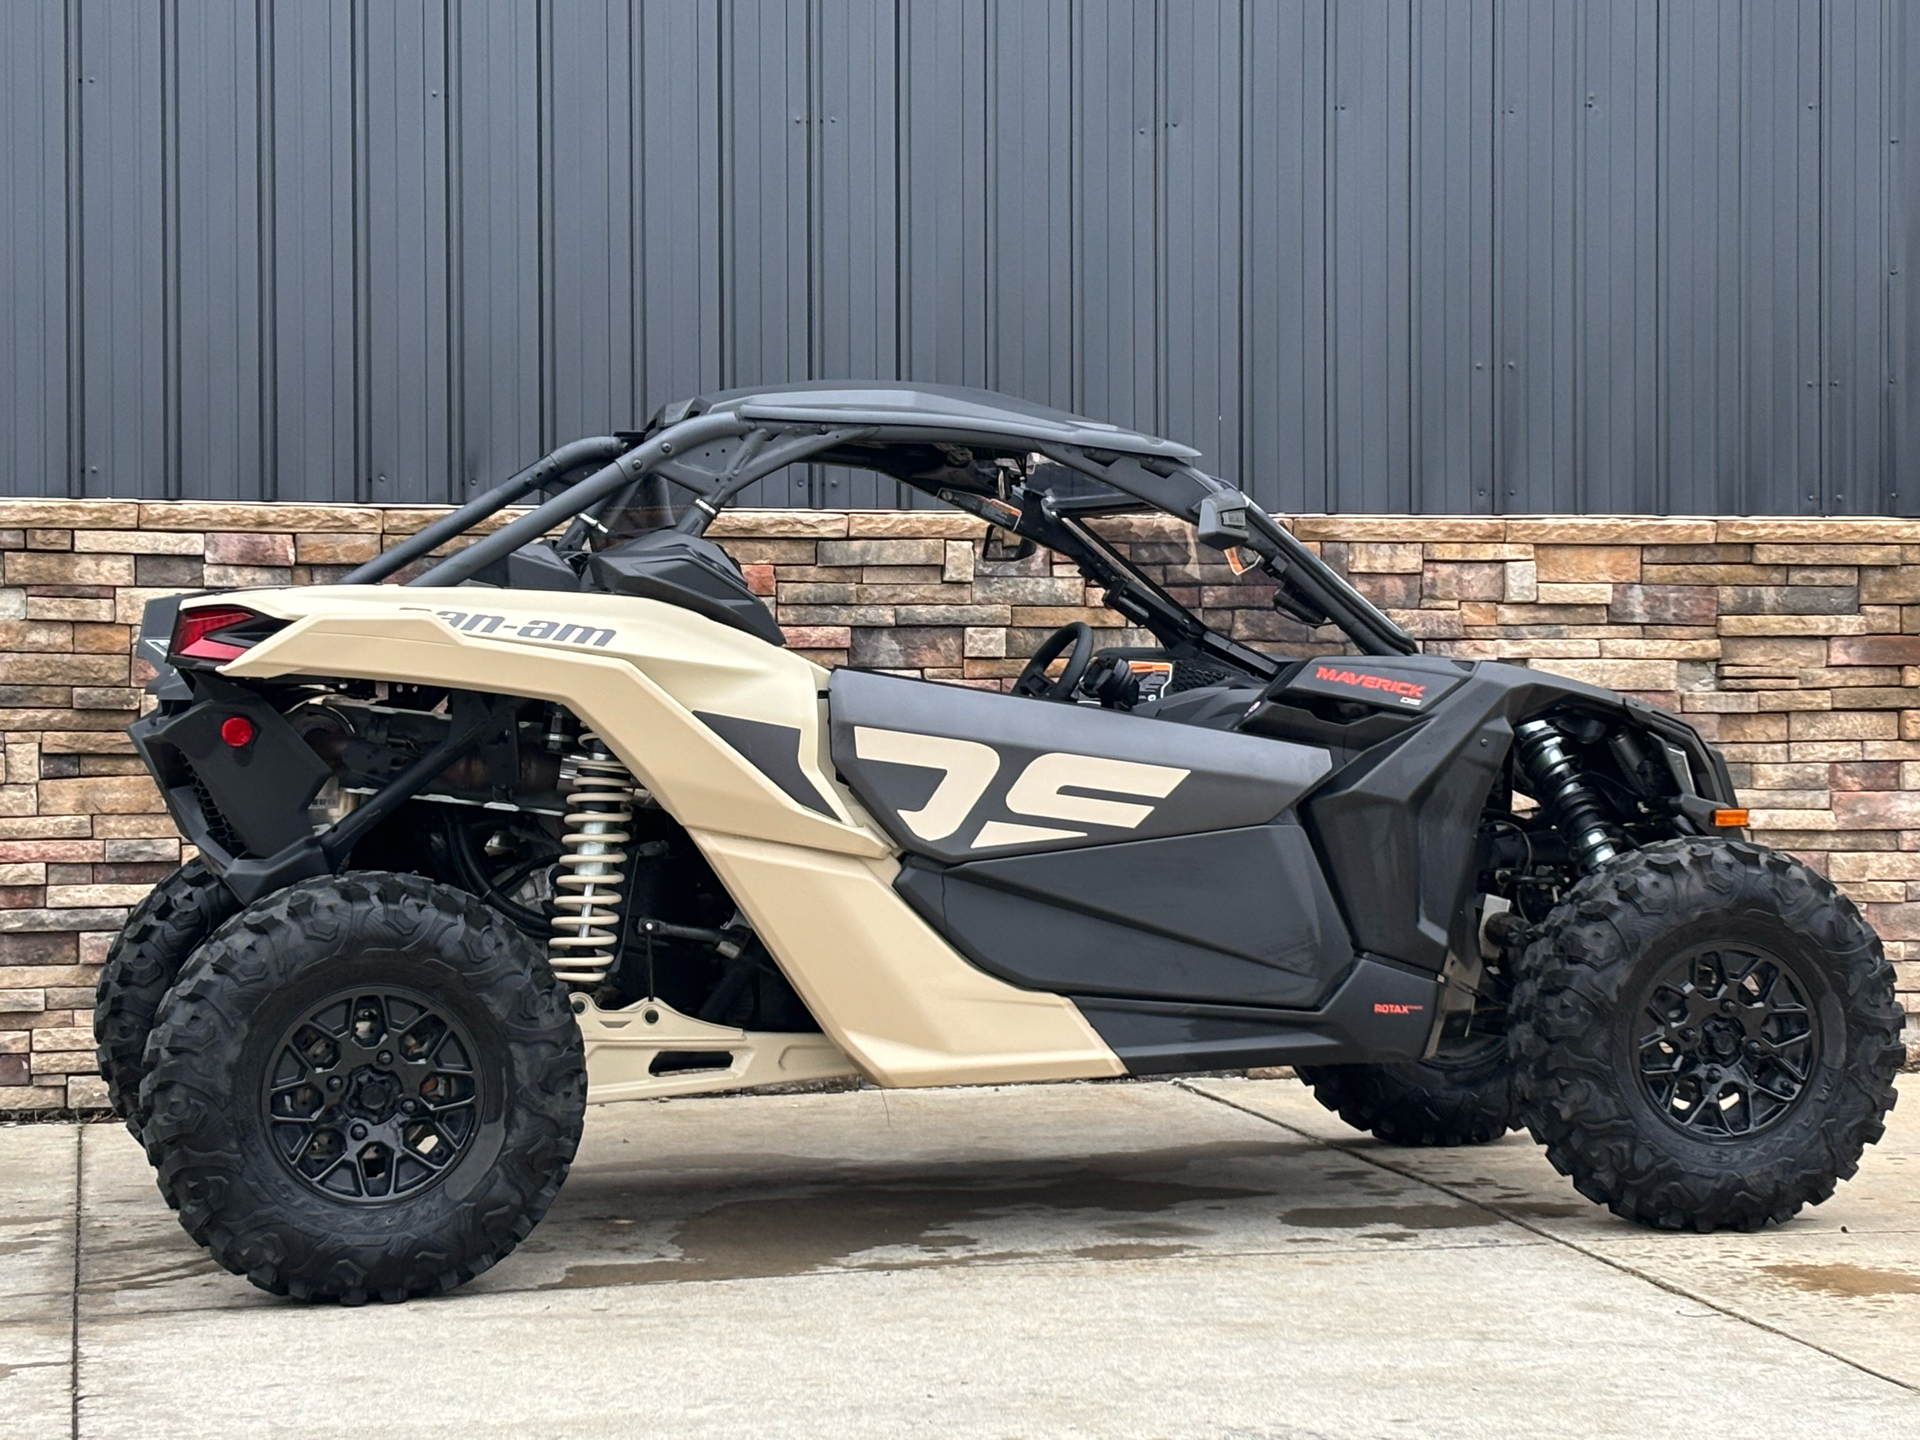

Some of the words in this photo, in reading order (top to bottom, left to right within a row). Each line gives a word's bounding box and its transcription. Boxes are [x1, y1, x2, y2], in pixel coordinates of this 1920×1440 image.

[399, 607, 617, 647] an-am
[1315, 666, 1425, 696] MAVERICK
[1373, 1003, 1409, 1014] ROTAX
